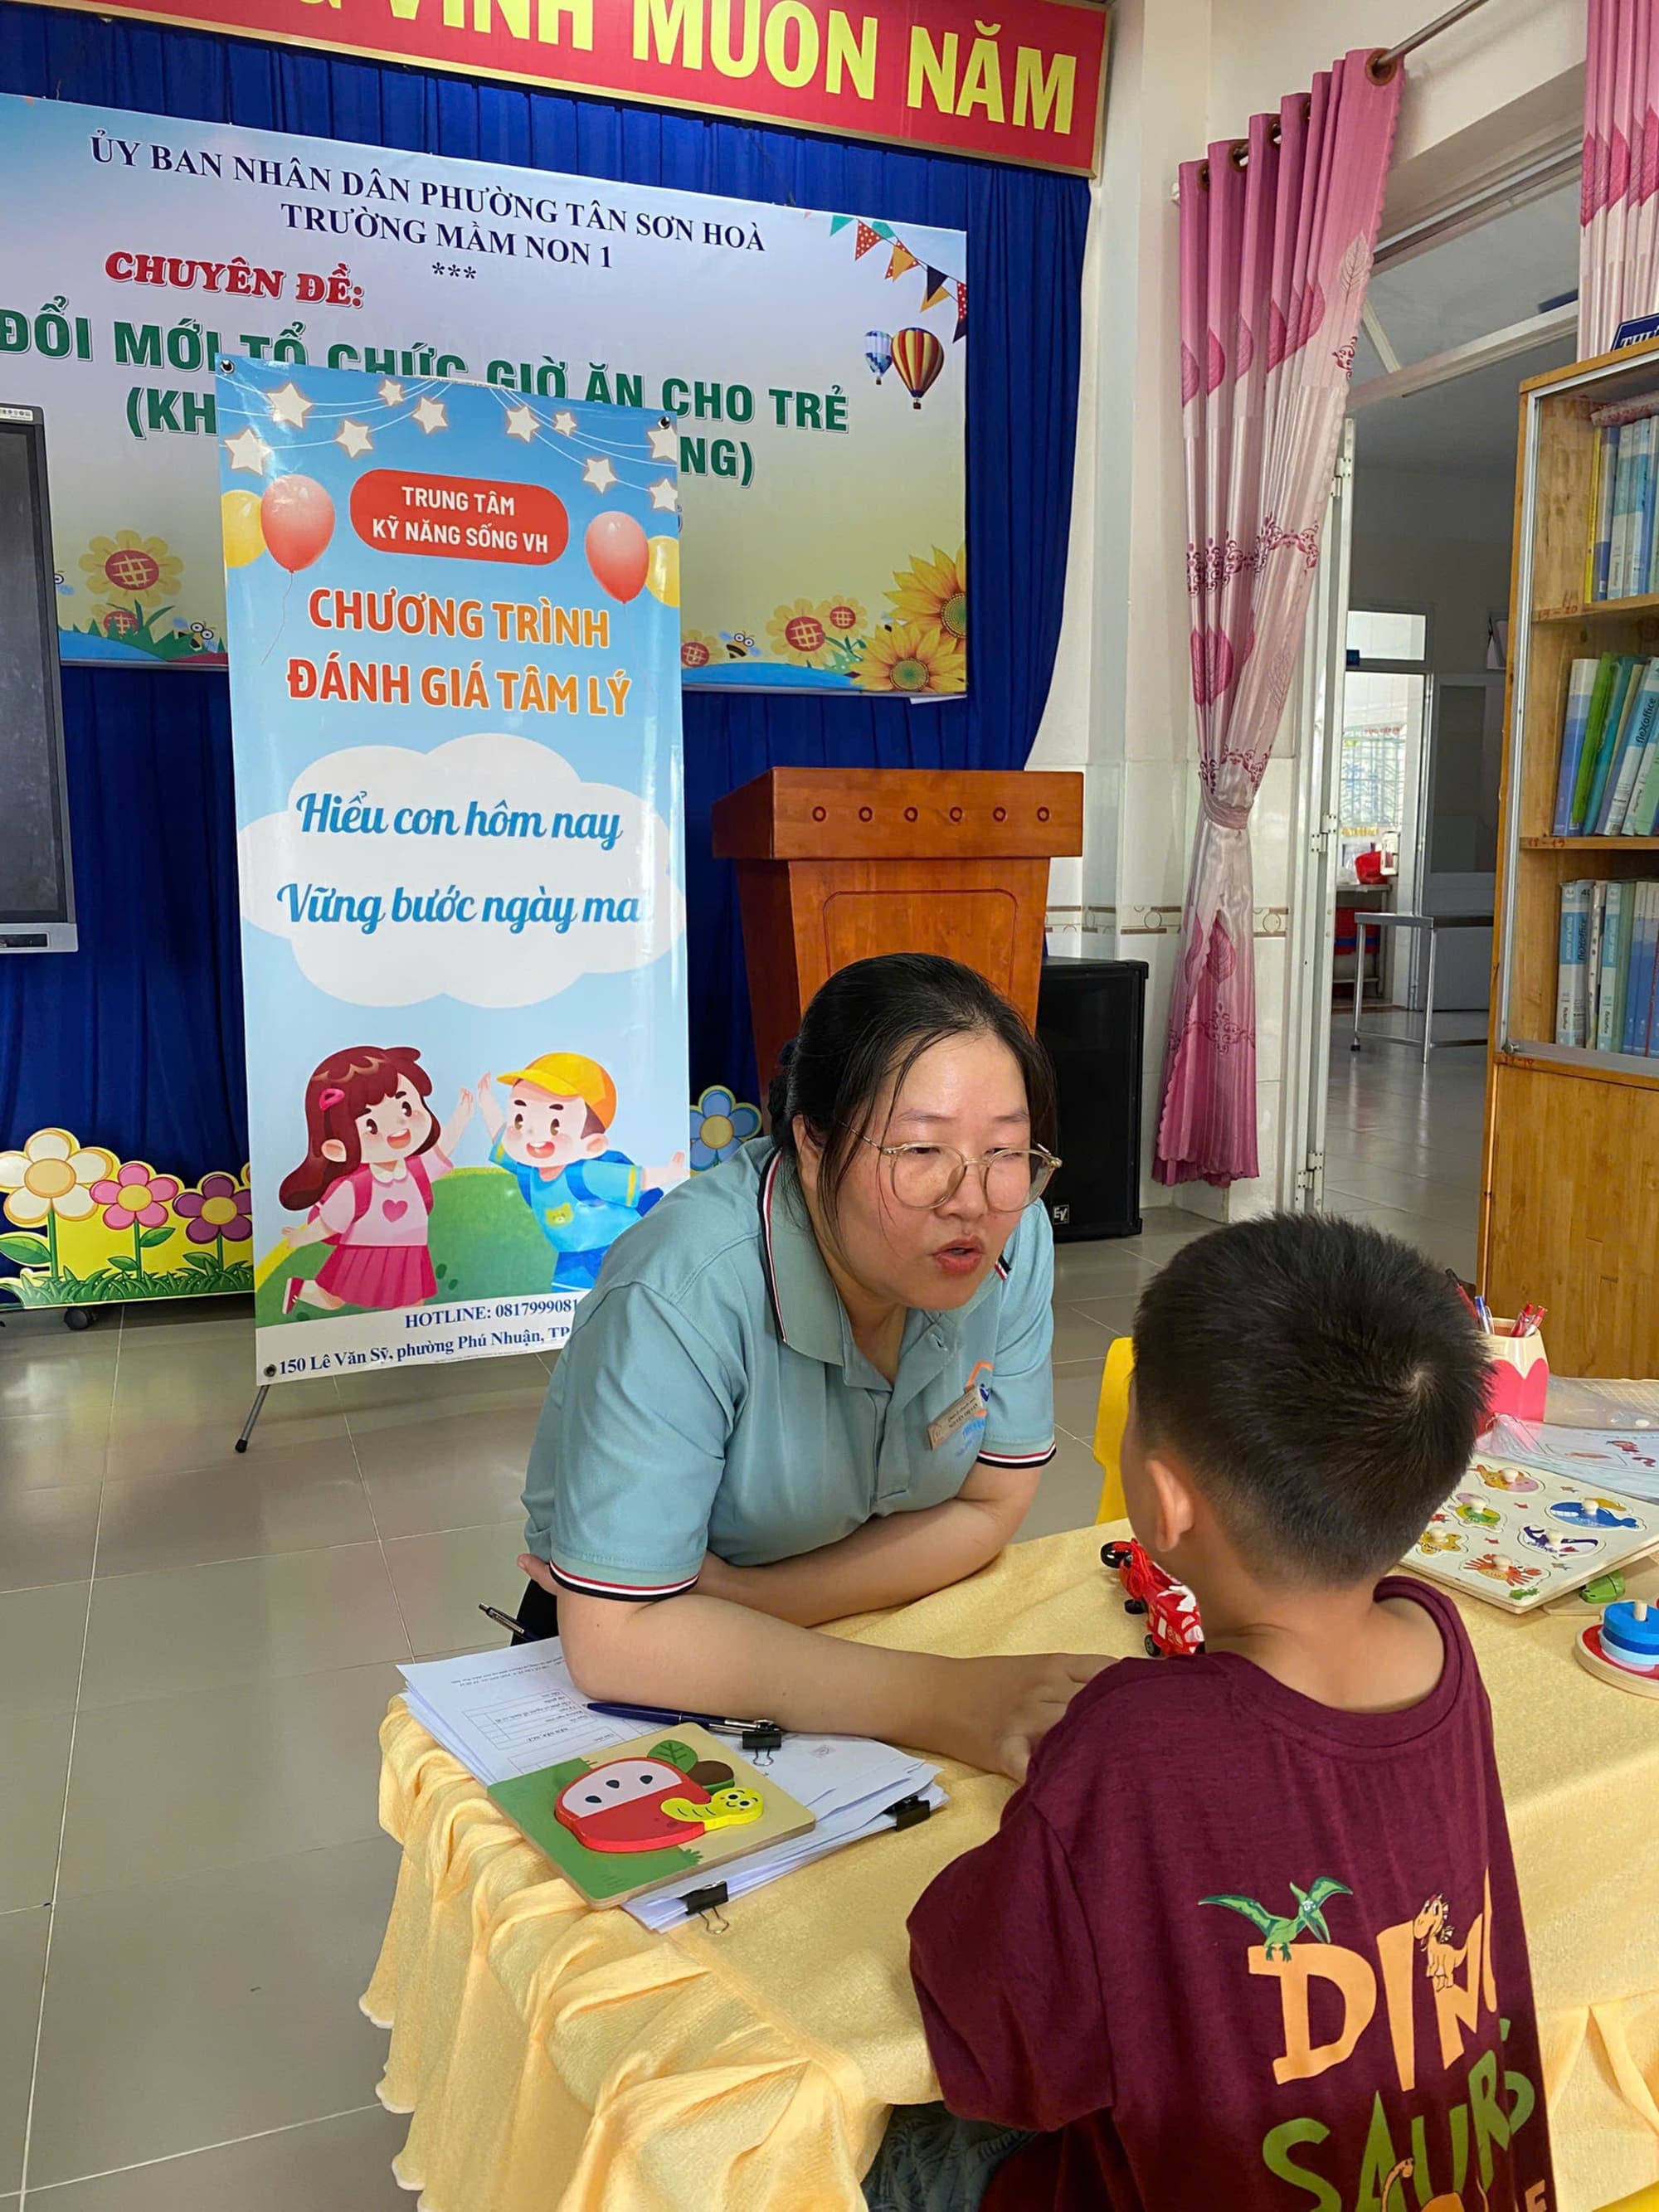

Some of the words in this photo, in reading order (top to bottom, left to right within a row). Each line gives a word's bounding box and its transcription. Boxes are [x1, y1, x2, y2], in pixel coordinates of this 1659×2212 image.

[907, 20, 1078, 135] NĂM
[90, 129, 139, 168] ỦY
[151, 144, 222, 178] BAN
[233, 157, 330, 193] NHÂN
[342, 168, 410, 203] DÂN
[421, 182, 557, 223] PHƯỜNG
[567, 196, 627, 232] TÂN
[636, 208, 695, 241] SƠN
[703, 219, 766, 252] HOÀ
[281, 202, 427, 245] TRƯỜNG
[526, 236, 591, 266] NON
[600, 246, 612, 268] 1
[105, 250, 285, 299] CHUYÊN
[296, 263, 364, 309] ĐỀ:
[0, 295, 92, 362] ĐỔI
[114, 318, 221, 373] MỚI
[487, 355, 567, 399] GIỜ
[585, 362, 644, 408] ĂN
[662, 377, 752, 423] CHO
[769, 384, 849, 433] TRẺ
[401, 486, 469, 513] TRUNG
[474, 489, 515, 516] TÂM
[372, 515, 399, 541] KỸ
[405, 518, 460, 546] NĂNG
[465, 521, 518, 551] SỐNG
[523, 532, 548, 554] VH
[308, 586, 484, 639] CHƯƠNG
[492, 597, 610, 649] TRÌNH
[287, 651, 411, 704] ĐÁNH
[421, 662, 489, 709] GIÁ
[497, 665, 578, 714] TÂM
[587, 669, 630, 717] LÝ
[296, 790, 388, 834] Hiểu
[393, 807, 460, 836] con
[464, 799, 547, 839] hôm
[551, 811, 624, 852] nay
[276, 882, 387, 935] Vững
[392, 884, 476, 923] bước
[481, 886, 577, 934] ngày
[1053, 1207, 1068, 1221] EV
[405, 1305, 491, 1328] HOTLINE:
[495, 1298, 577, 1317] 0817999081
[280, 1357, 306, 1375] 150
[310, 1354, 331, 1371] Lê
[333, 1350, 367, 1368] Văn
[370, 1346, 393, 1364] Sỹ,
[397, 1340, 454, 1363] phường
[458, 1334, 487, 1349] Phú
[491, 1329, 545, 1347] Nhuận,
[548, 1326, 571, 1339] TP
